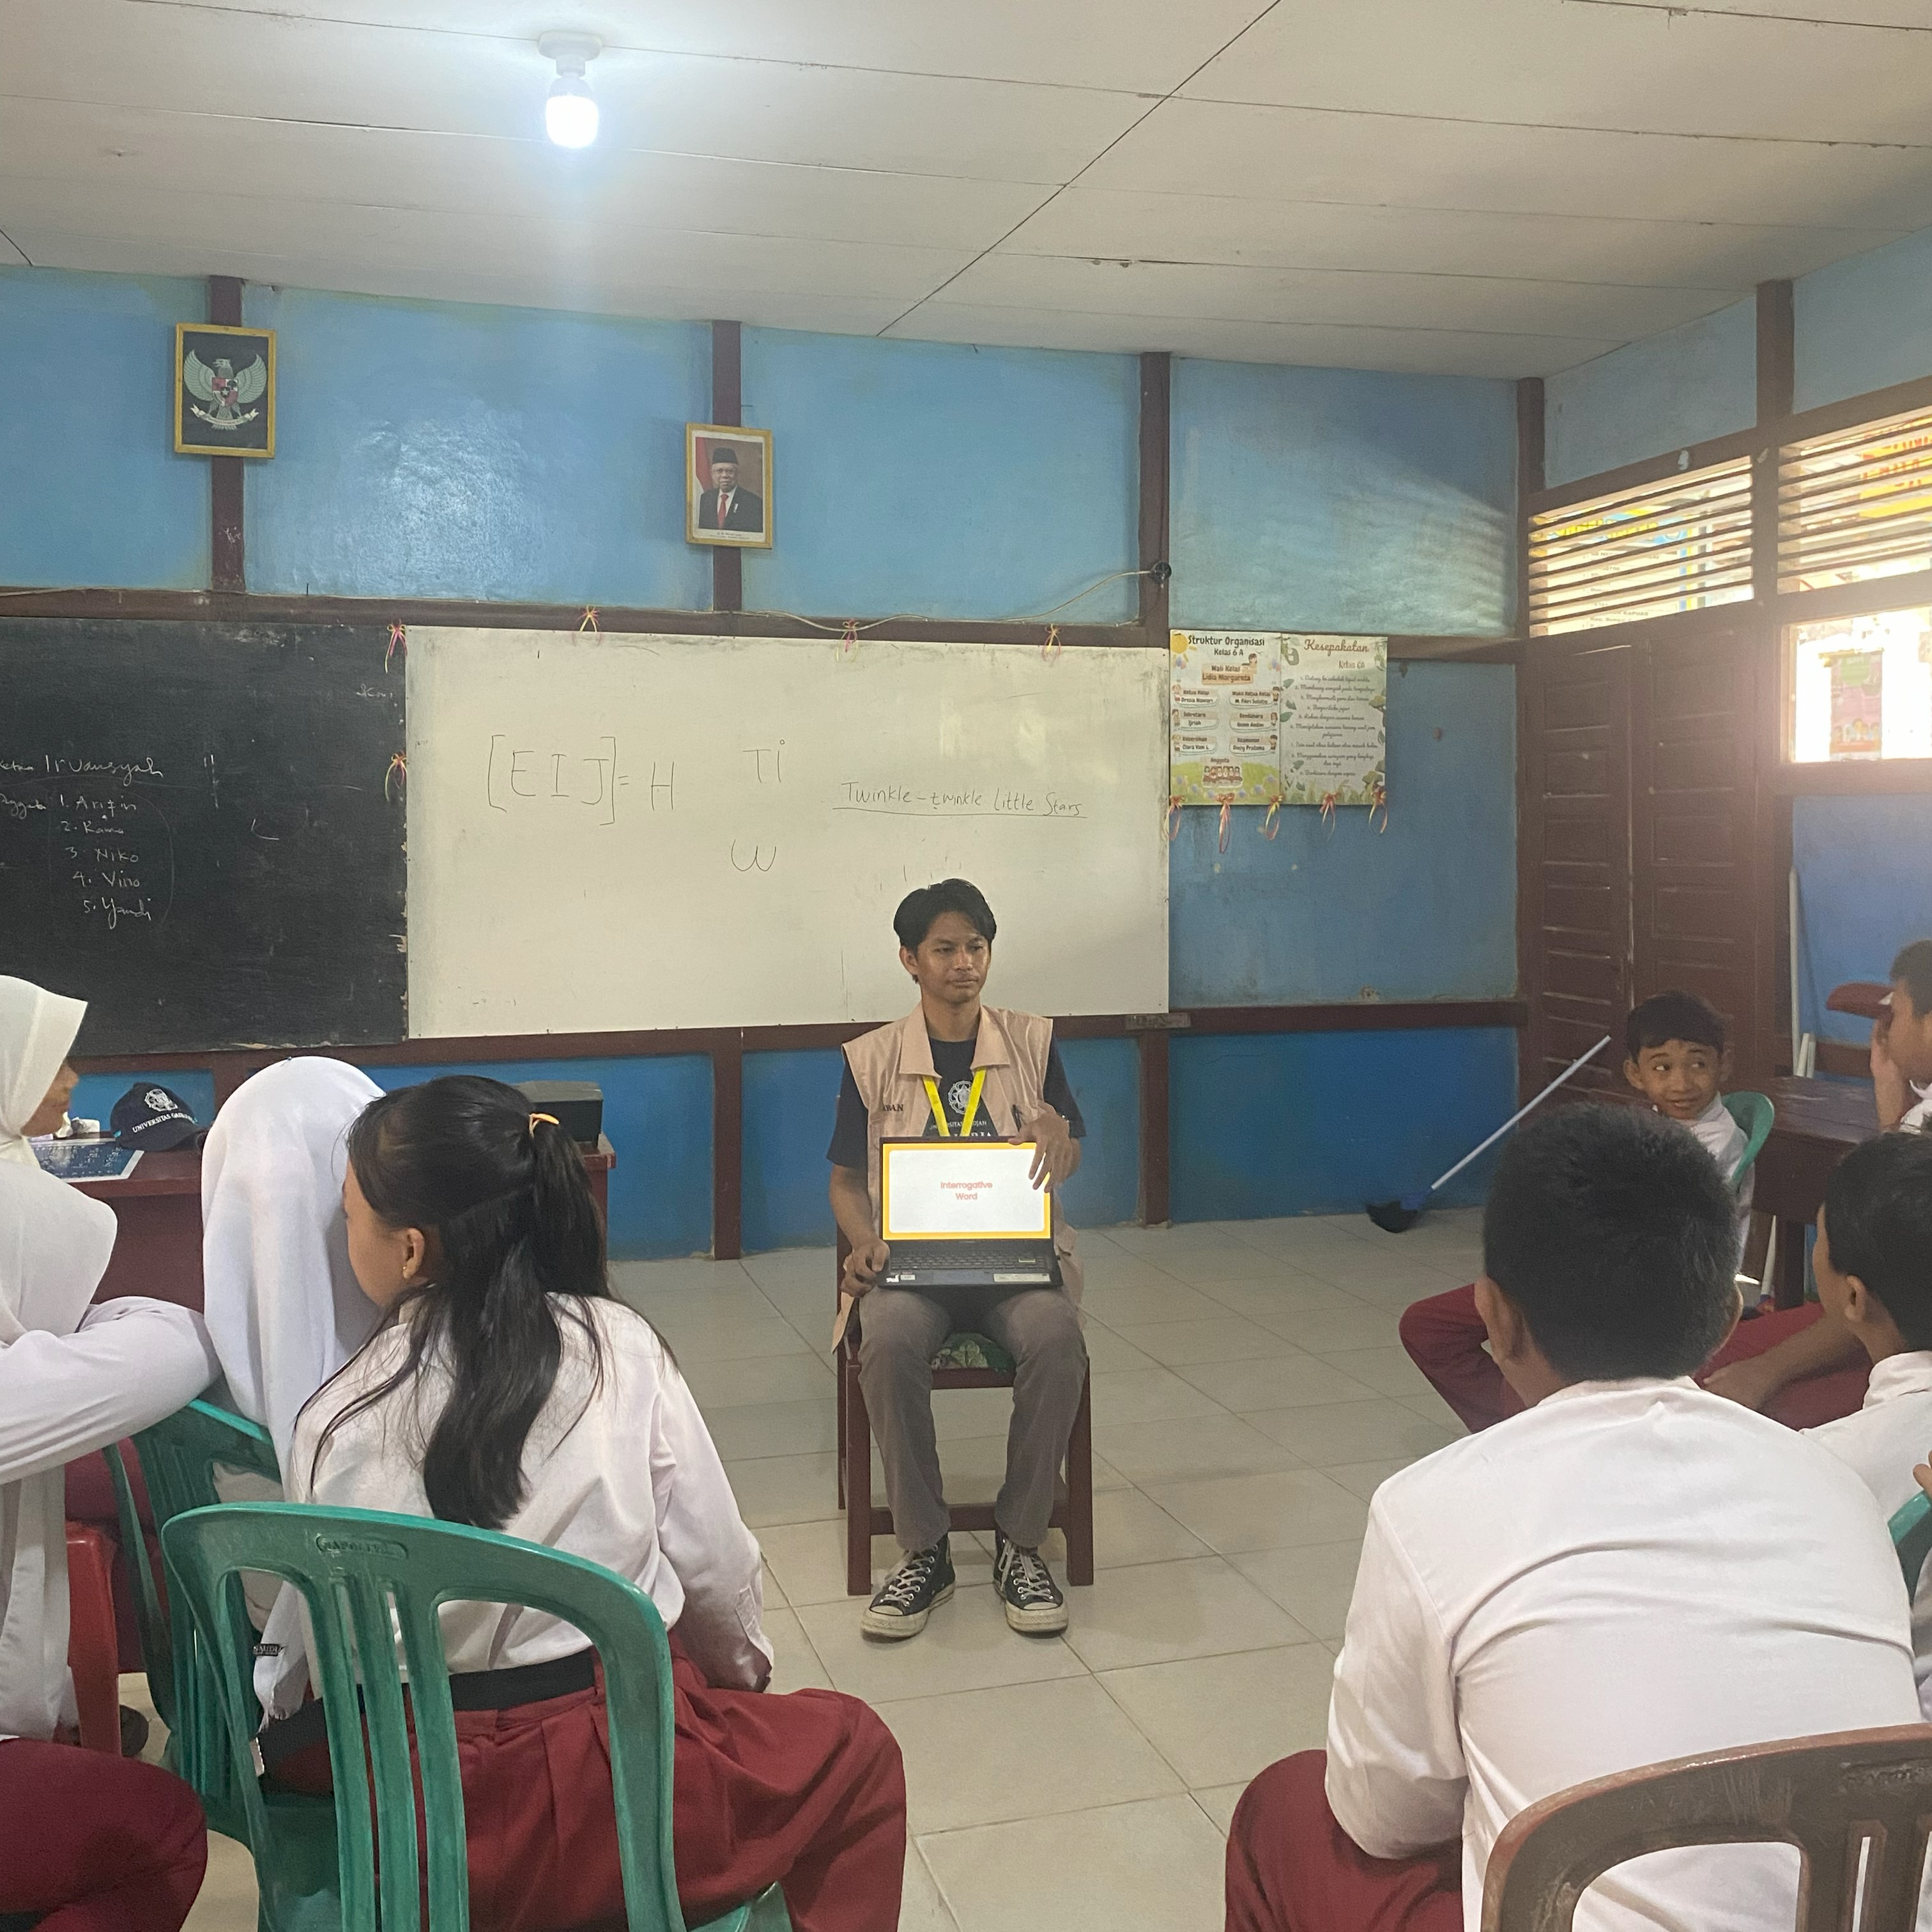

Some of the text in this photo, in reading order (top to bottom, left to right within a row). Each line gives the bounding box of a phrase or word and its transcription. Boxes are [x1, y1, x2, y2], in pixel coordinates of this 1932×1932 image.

[1188, 634, 1265, 648] Struktur Organisasi
[1304, 639, 1370, 657] Kesepakatan
[1338, 661, 1356, 669] Kelas
[1044, 792, 1082, 816] Stars
[95, 848, 139, 862] Niko
[72, 871, 92, 887] 4.
[83, 900, 96, 914] 5.
[132, 1114, 171, 1133] UNIVERSITAS
[940, 1181, 993, 1191] Interrogative
[955, 1192, 977, 1200] Word
